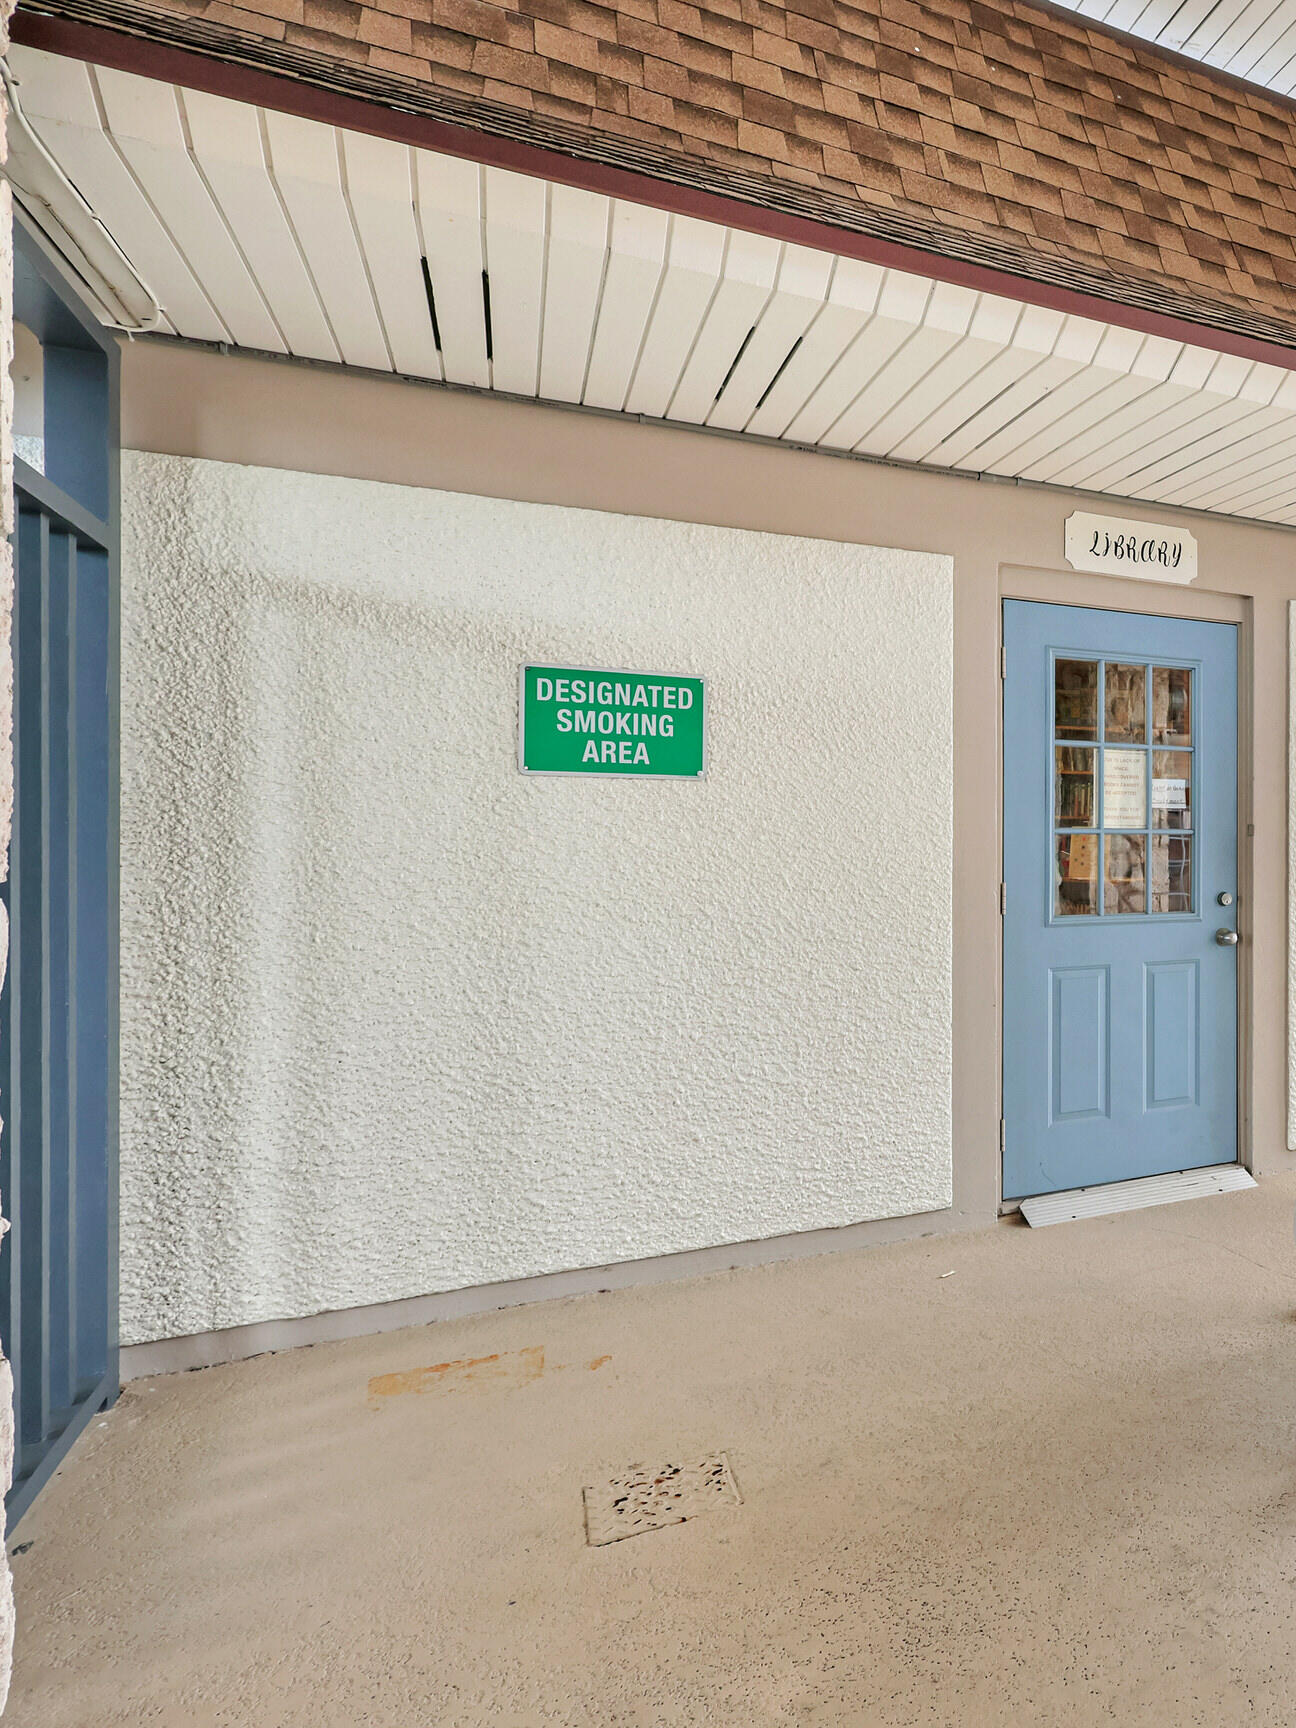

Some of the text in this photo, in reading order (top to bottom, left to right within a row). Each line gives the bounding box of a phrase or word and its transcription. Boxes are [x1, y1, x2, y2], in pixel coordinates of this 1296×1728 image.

[536, 677, 693, 710] DESIGNATED
[556, 708, 674, 737] SMOKING
[581, 739, 650, 765] AREA
